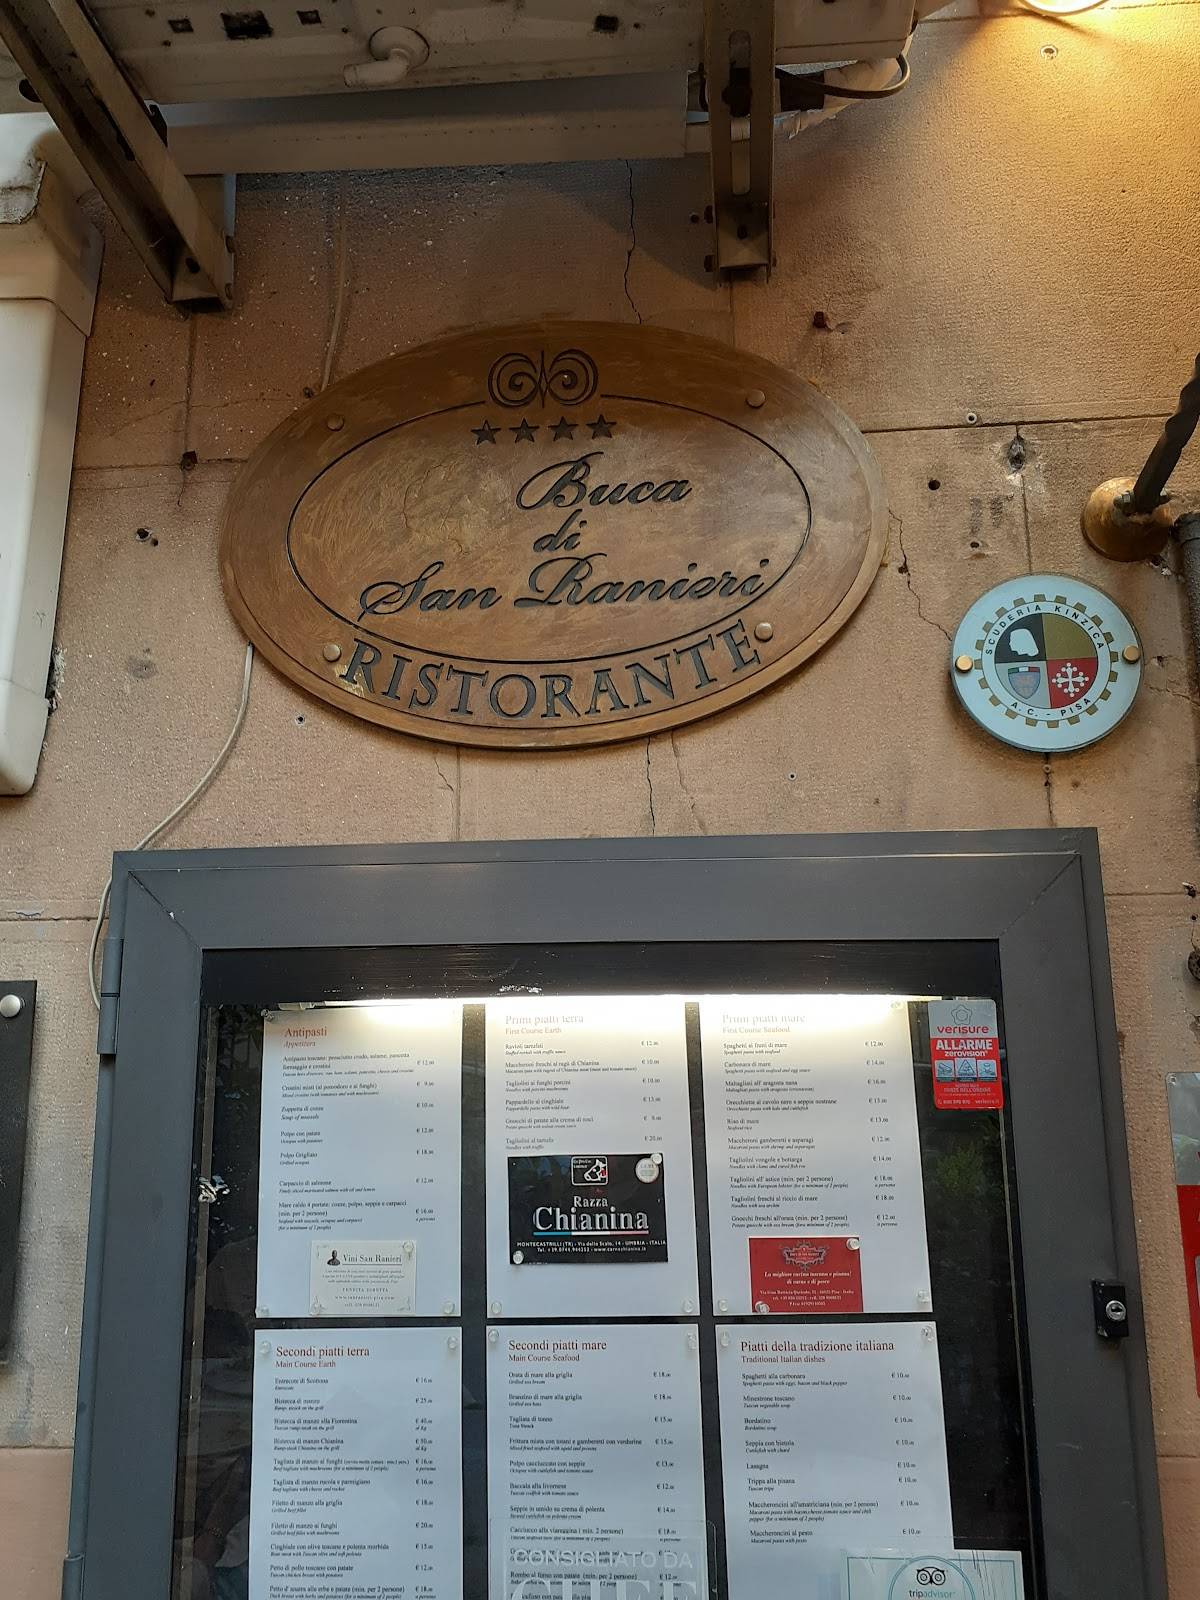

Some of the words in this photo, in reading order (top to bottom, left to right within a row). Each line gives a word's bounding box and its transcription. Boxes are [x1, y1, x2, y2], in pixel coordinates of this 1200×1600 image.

[515, 452, 693, 510] Buca
[532, 510, 588, 554] di
[357, 560, 502, 622] San
[513, 553, 770, 610] Ranieri
[986, 605, 1041, 655] SCUDERIA
[1055, 606, 1104, 649] KINZICA
[341, 618, 762, 720] RISTORANTE
[1060, 698, 1091, 716] PISA
[505, 1016, 532, 1024] Primi
[534, 1015, 559, 1026] piatti
[562, 1015, 584, 1023] terra
[722, 1014, 749, 1023] Primi
[752, 1014, 779, 1025] piatti
[781, 1014, 806, 1023] mare
[285, 1026, 327, 1039] Antipasti
[936, 1040, 993, 1050] ALLARME
[573, 1196, 608, 1207] Razza
[533, 1207, 648, 1230] Chianina
[343, 1254, 358, 1263] Vini
[360, 1254, 373, 1263] San
[375, 1254, 401, 1263] Ranieri
[276, 1346, 316, 1357] Secondi
[319, 1345, 344, 1359] piatti
[347, 1346, 369, 1356] terra
[509, 1340, 549, 1351] Secondi
[553, 1340, 578, 1353] piatti
[582, 1341, 607, 1350] mare
[741, 1341, 768, 1352] Piatti
[771, 1340, 797, 1352] della
[800, 1340, 852, 1351] tradizione
[856, 1340, 894, 1351] italiana
[509, 1354, 526, 1362] Main
[527, 1354, 550, 1362] Course
[553, 1354, 580, 1362] Seafood
[741, 1355, 779, 1363] Traditional
[781, 1355, 802, 1363] Italian
[804, 1355, 825, 1363] dishes
[664, 1552, 692, 1569] DA
